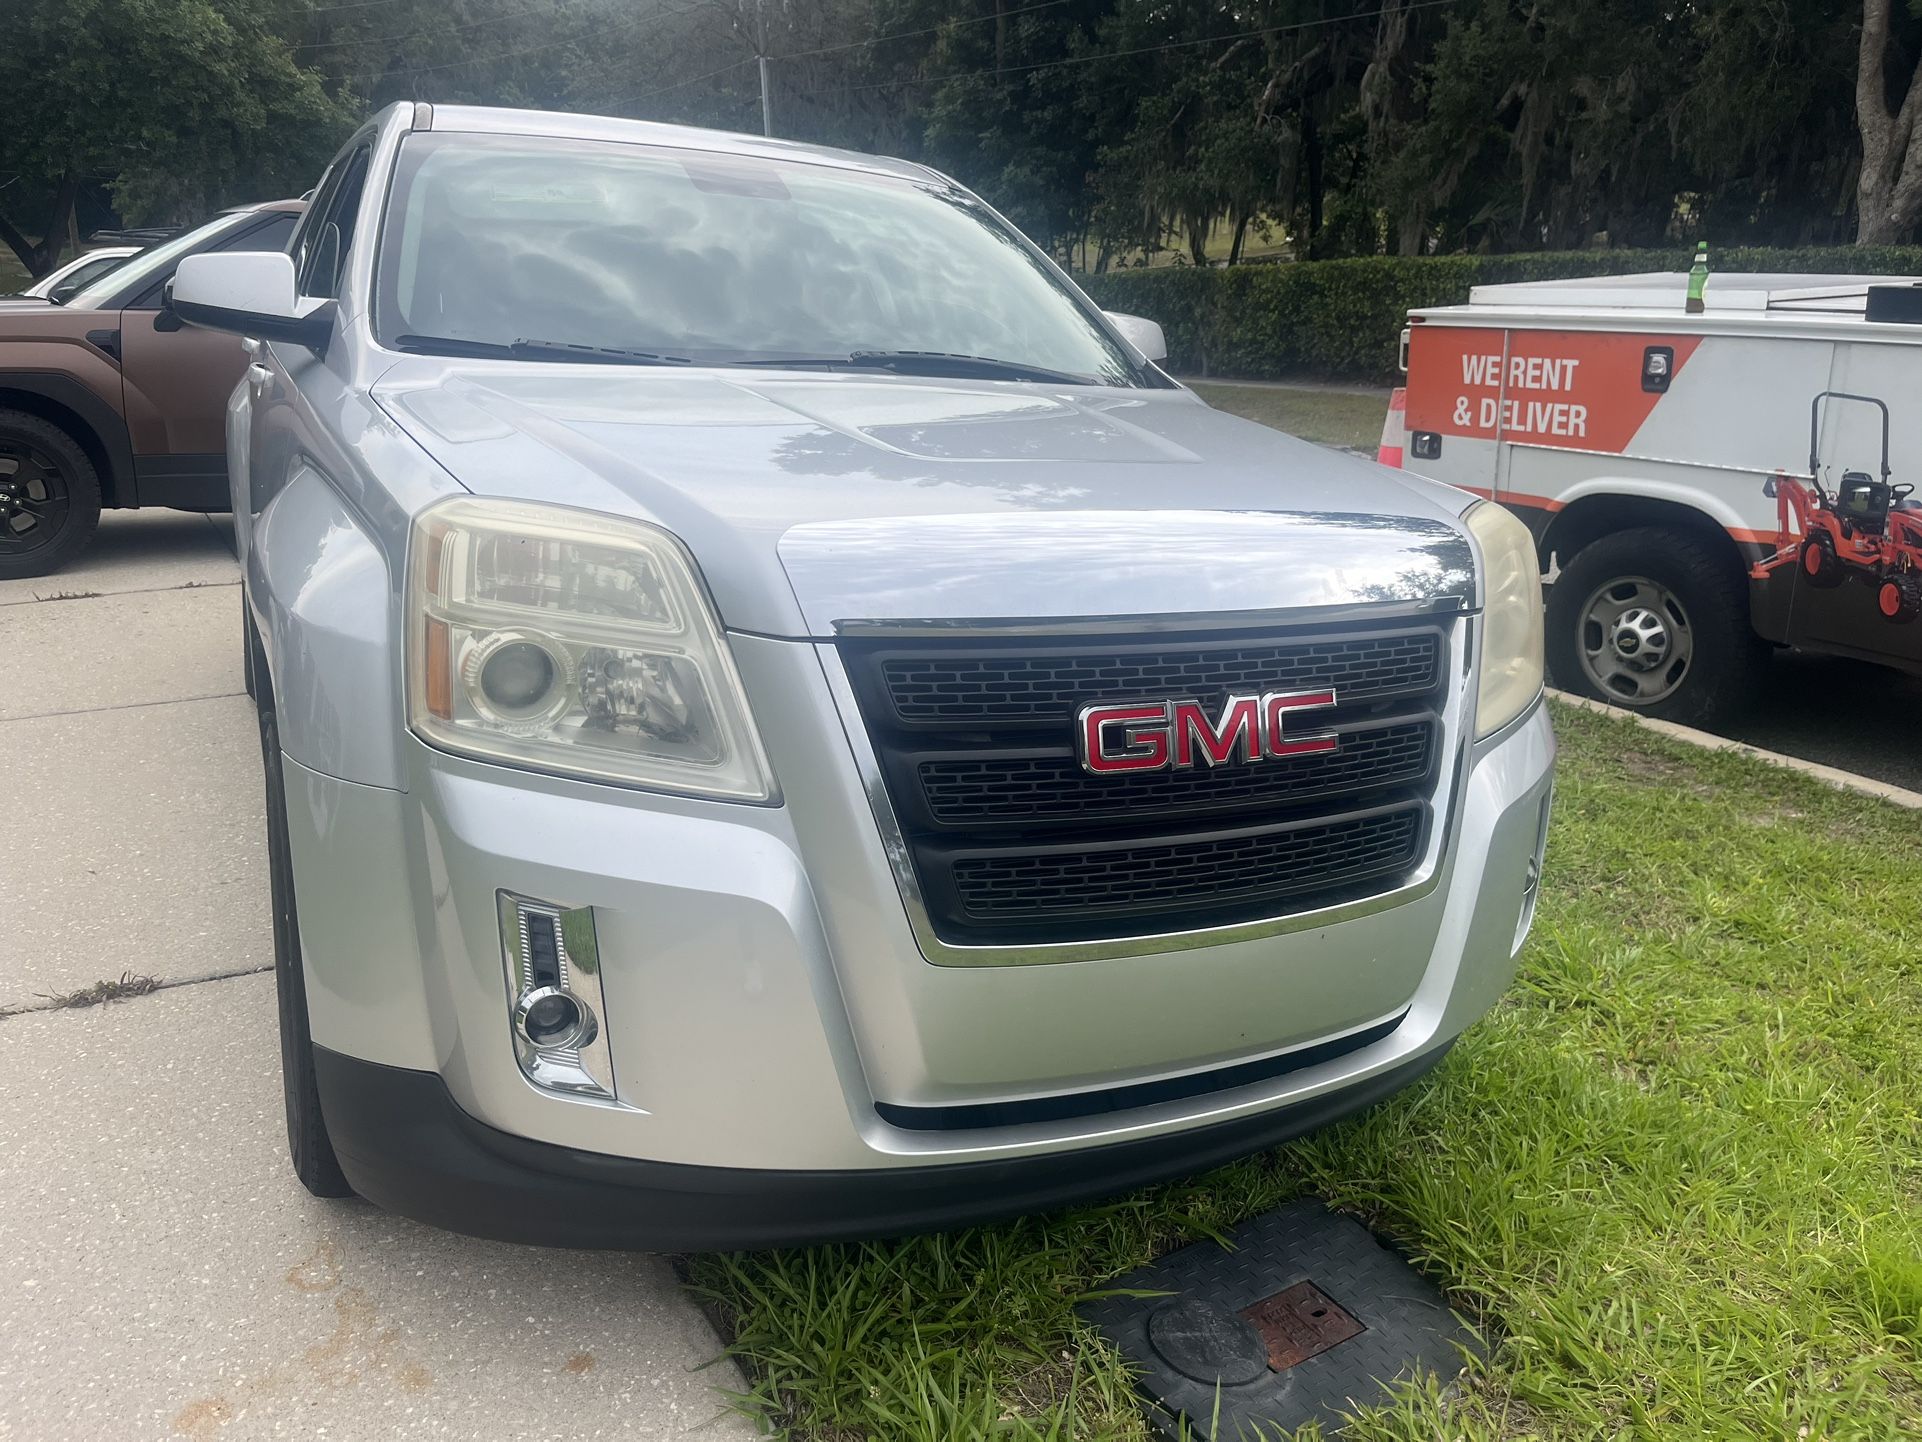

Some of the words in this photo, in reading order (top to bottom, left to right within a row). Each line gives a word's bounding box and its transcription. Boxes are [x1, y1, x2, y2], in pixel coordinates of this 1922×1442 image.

[1462, 354, 1501, 387] WE
[1508, 356, 1580, 391] RENT
[1453, 396, 1472, 426] &
[1479, 398, 1587, 437] DELIVER
[1077, 688, 1339, 775] GMC
